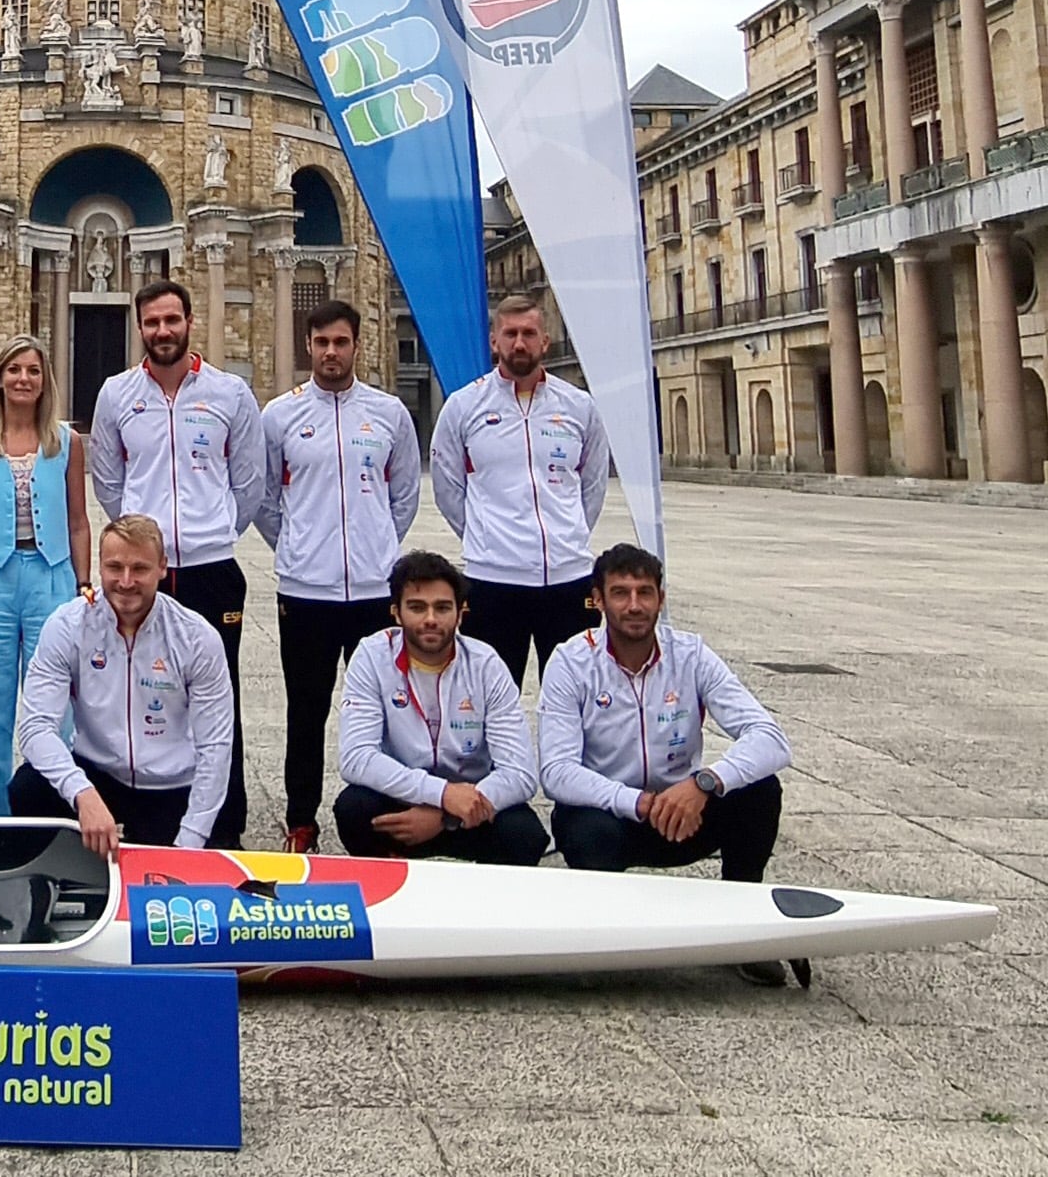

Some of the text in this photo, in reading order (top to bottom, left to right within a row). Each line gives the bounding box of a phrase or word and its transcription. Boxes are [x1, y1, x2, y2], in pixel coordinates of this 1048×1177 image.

[228, 898, 351, 923] Asturias
[230, 922, 355, 944] paraíso natural
[3, 1073, 112, 1106] natural
